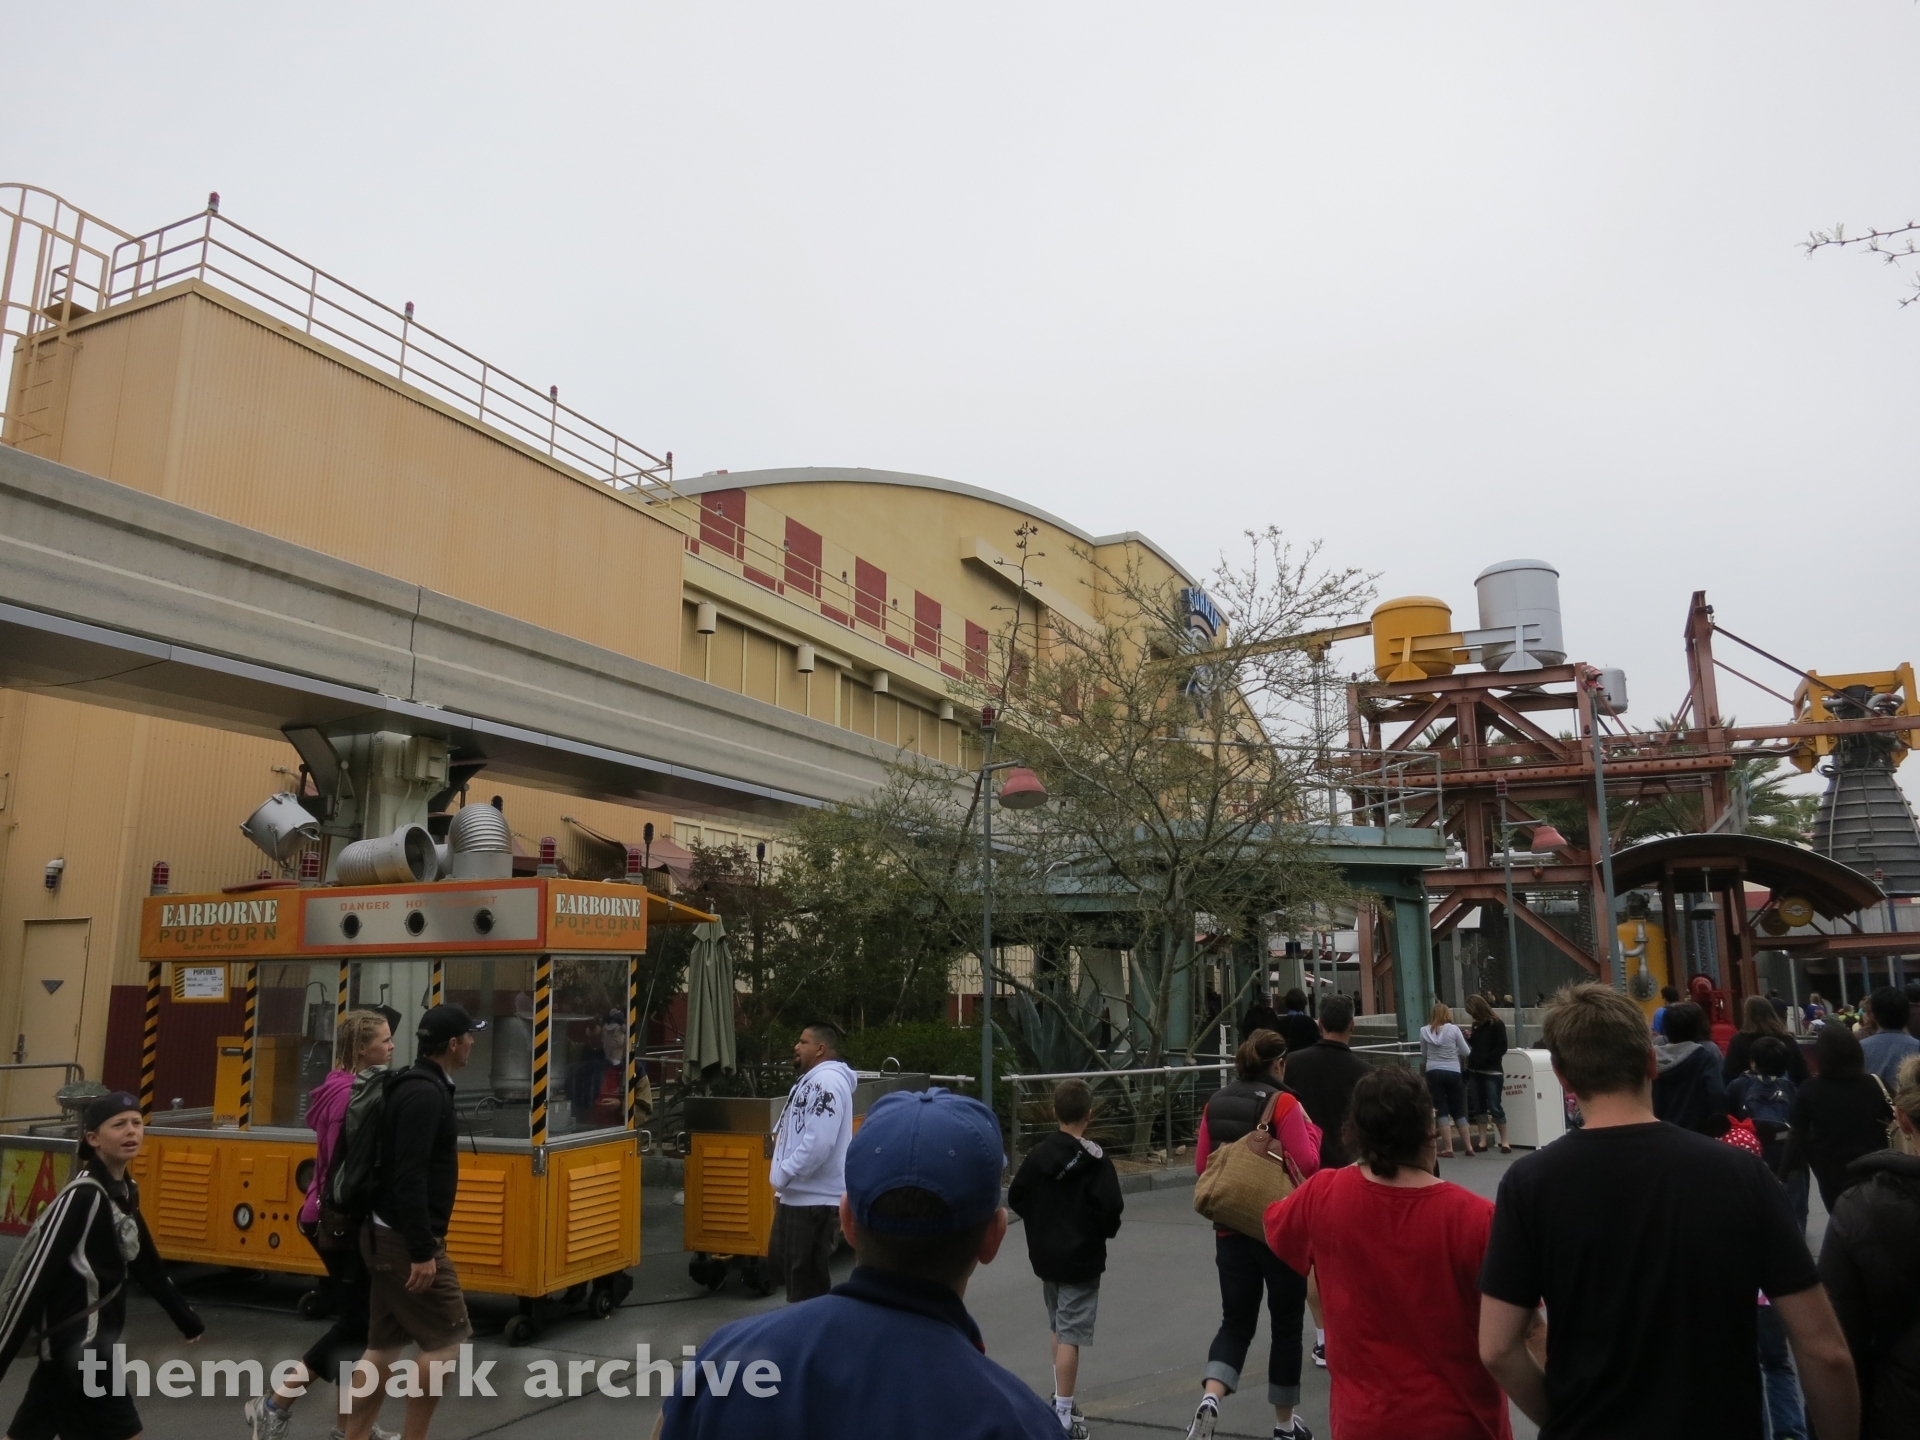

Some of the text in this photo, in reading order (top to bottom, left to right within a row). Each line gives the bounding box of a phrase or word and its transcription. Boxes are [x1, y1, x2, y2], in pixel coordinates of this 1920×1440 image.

[161, 900, 278, 927] EARBORNE
[340, 901, 390, 911] DANGER
[555, 893, 641, 918] EARBORNE
[554, 915, 641, 931] POPCORN
[159, 926, 277, 943] POPCORN
